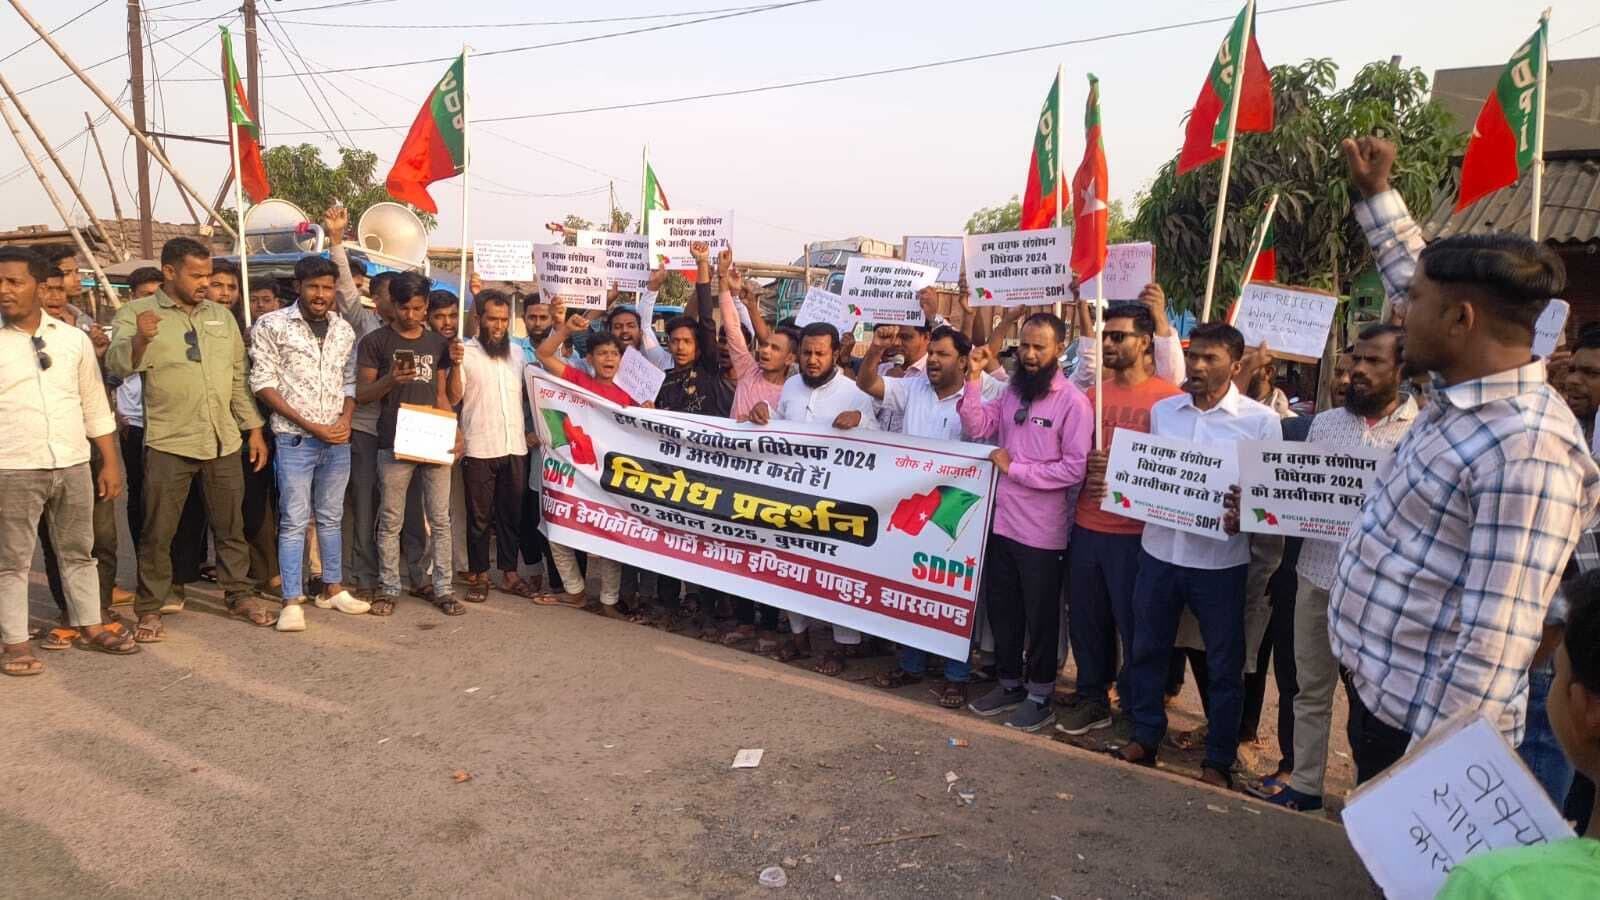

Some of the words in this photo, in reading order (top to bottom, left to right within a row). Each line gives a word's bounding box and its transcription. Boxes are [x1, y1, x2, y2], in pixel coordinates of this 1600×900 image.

[699, 229, 715, 237] 2024
[913, 241, 950, 256] SAVE
[981, 241, 995, 252] हम
[1022, 236, 1056, 249] संशोधन
[627, 251, 642, 259] 2024
[990, 253, 1023, 265] विधेयक
[1025, 252, 1047, 263] 2024
[570, 265, 588, 274] 2024
[974, 267, 986, 279] को
[988, 265, 1029, 279] अस्वीकार
[1031, 263, 1052, 277] करते
[893, 279, 912, 288] 2024
[686, 428, 752, 452] संशोधन
[758, 435, 829, 461] विधेयक
[834, 447, 876, 471] 2024
[1132, 441, 1147, 454] हम
[1180, 450, 1224, 469] संशोधन
[659, 438, 680, 458] को
[686, 447, 763, 475] अस्वीकार
[766, 462, 806, 484] करते
[923, 460, 933, 472] से
[1137, 457, 1177, 476] विधेयक
[1180, 469, 1207, 484] 2024
[1262, 452, 1282, 464] हम
[1325, 453, 1377, 471] संशोधन
[1115, 470, 1130, 483] को
[1132, 474, 1182, 496] अस्वीकार
[1183, 486, 1210, 502] करते
[1274, 468, 1326, 484] विधेयक
[1330, 474, 1363, 489] 2024
[610, 456, 723, 511] विरोध
[731, 492, 869, 539] प्रदर्शन
[1251, 484, 1269, 499] को
[1273, 487, 1335, 504] अस्वीकार
[630, 503, 650, 516] 02
[711, 522, 766, 544] 2025,
[774, 534, 839, 558] बुधवार
[576, 501, 661, 543] डेमोक्रेटिक
[703, 540, 744, 565] ऑफ
[748, 550, 811, 584] इण्डिया
[880, 585, 970, 628] झारखण्ड
